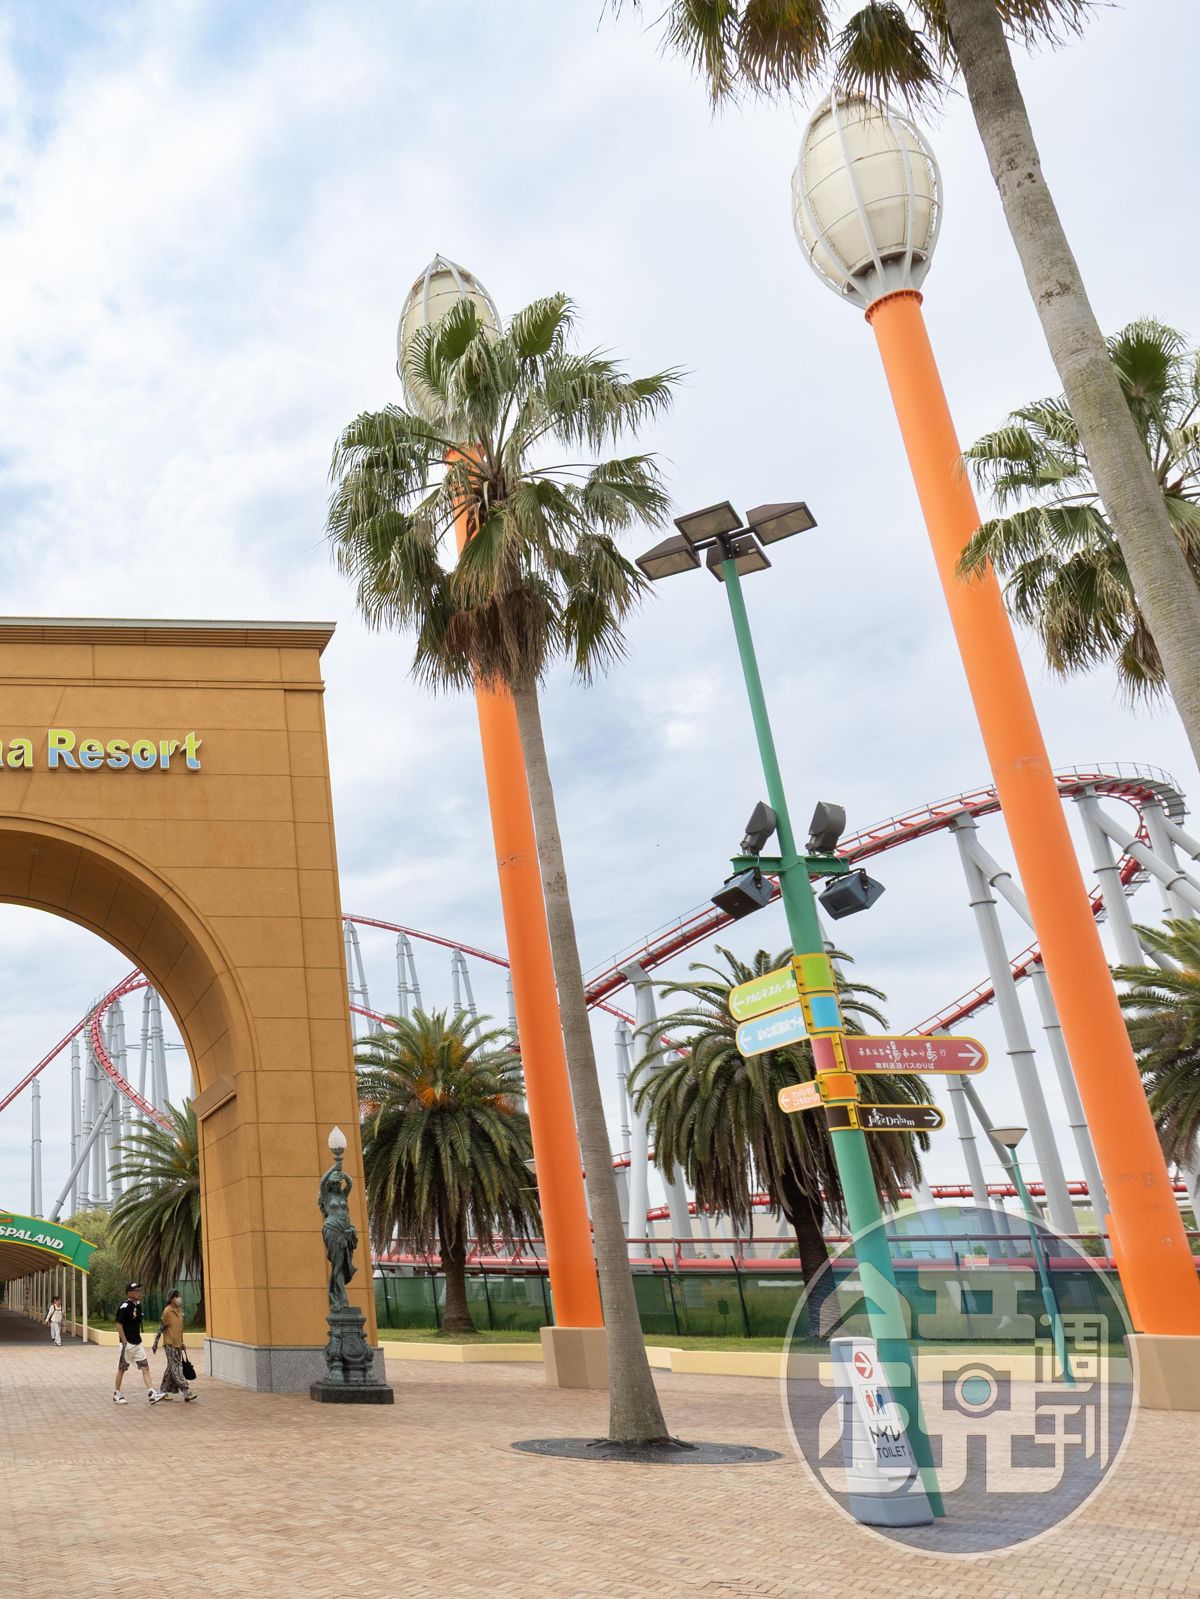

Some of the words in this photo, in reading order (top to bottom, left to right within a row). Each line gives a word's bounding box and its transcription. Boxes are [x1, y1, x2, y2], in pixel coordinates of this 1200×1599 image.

[47, 728, 203, 771] Resort
[868, 1424, 901, 1444] トイレ
[876, 1445, 907, 1458] TOILET
